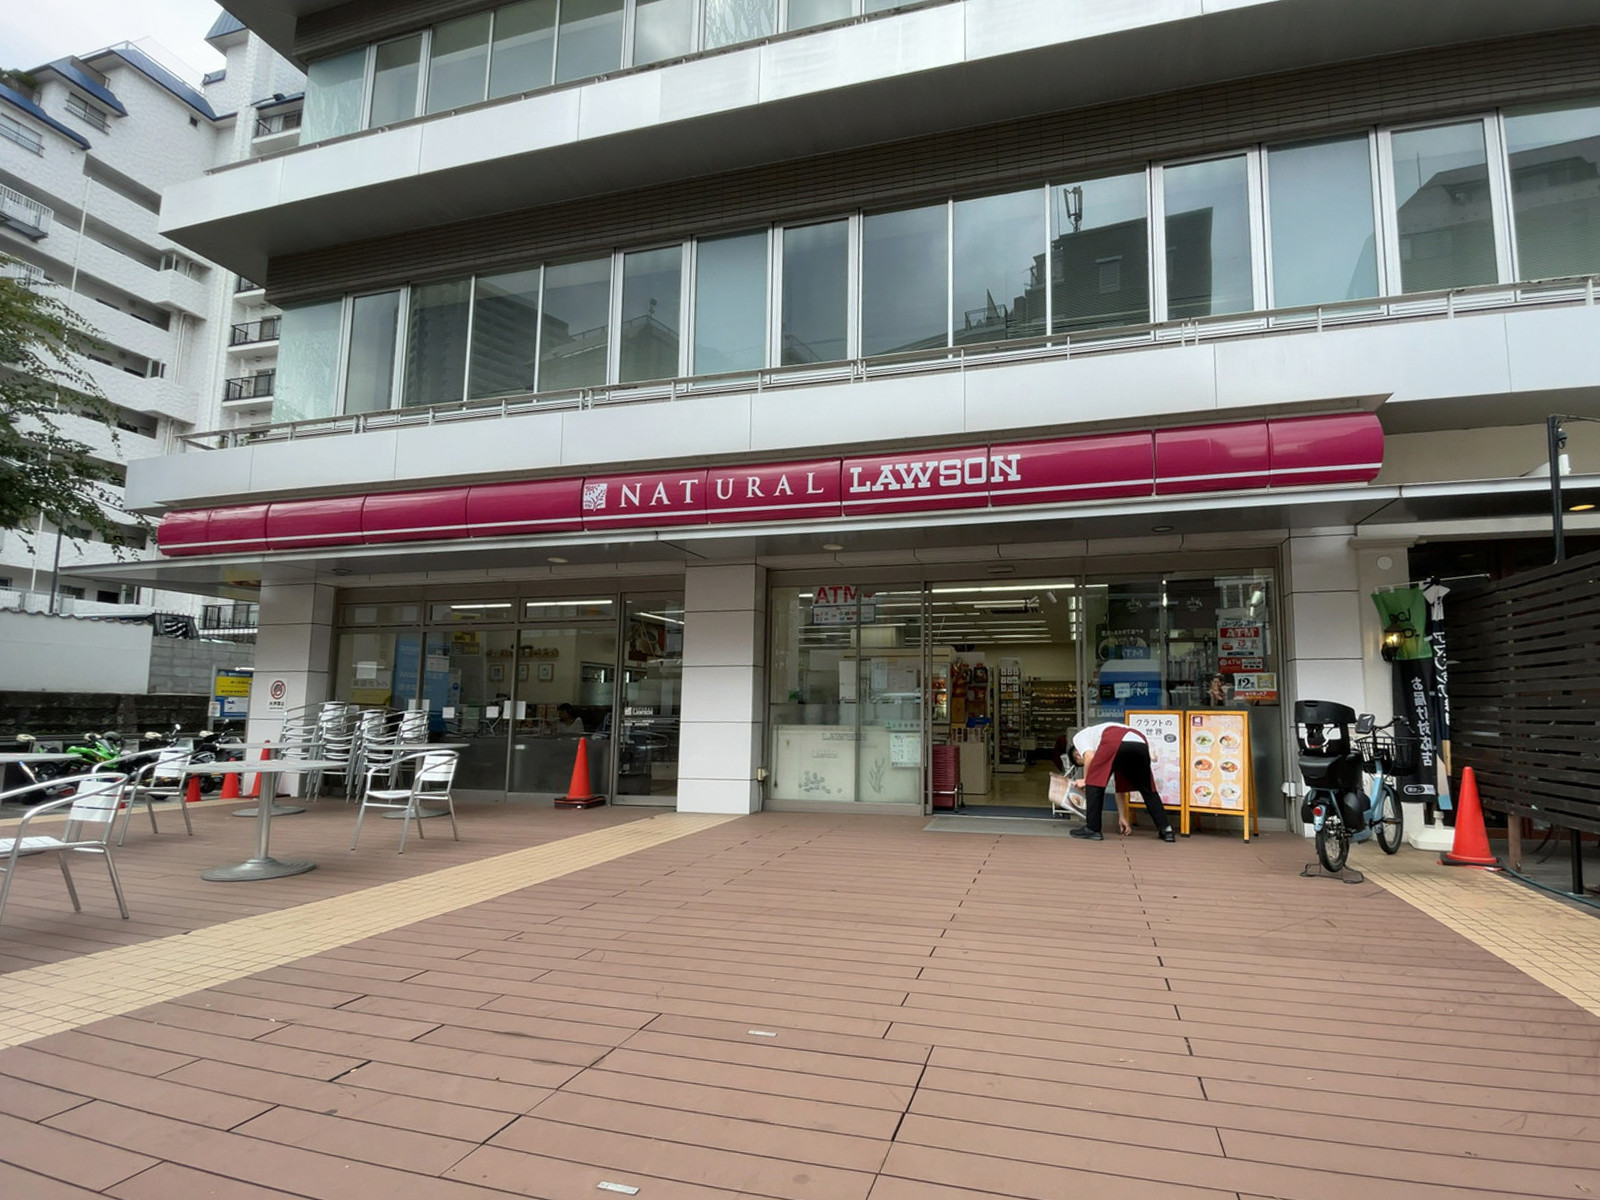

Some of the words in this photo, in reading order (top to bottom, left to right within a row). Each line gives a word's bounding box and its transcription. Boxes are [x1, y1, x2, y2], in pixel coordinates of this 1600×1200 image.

[619, 471, 824, 508] NATURAL
[849, 453, 1022, 493] LAWSON
[1226, 627, 1258, 638] ATM
[1136, 719, 1173, 727] クラフトの
[1145, 728, 1163, 736] 世界
